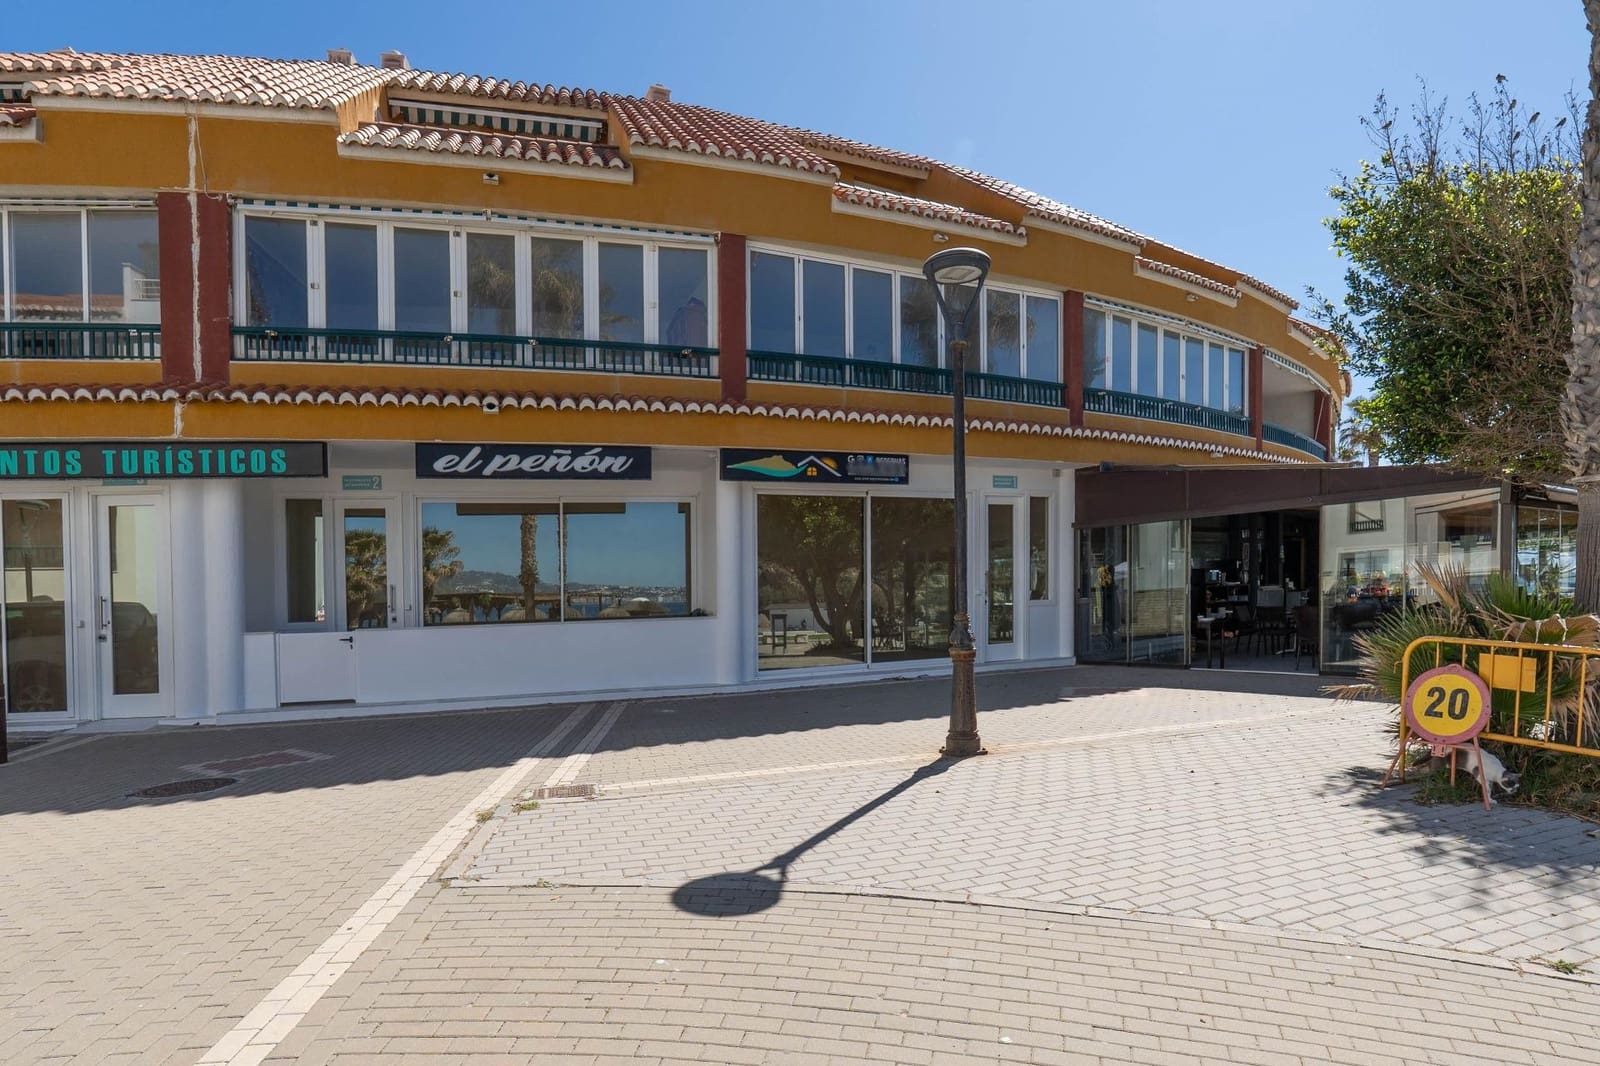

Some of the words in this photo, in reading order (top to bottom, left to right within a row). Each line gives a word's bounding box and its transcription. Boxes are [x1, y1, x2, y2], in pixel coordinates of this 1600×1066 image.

[0, 449, 82, 475] NTOS
[102, 446, 287, 475] TURÍSTICOS
[433, 446, 483, 473] el
[482, 447, 633, 477] peñón
[372, 476, 380, 489] 2
[1424, 686, 1470, 720] 20
